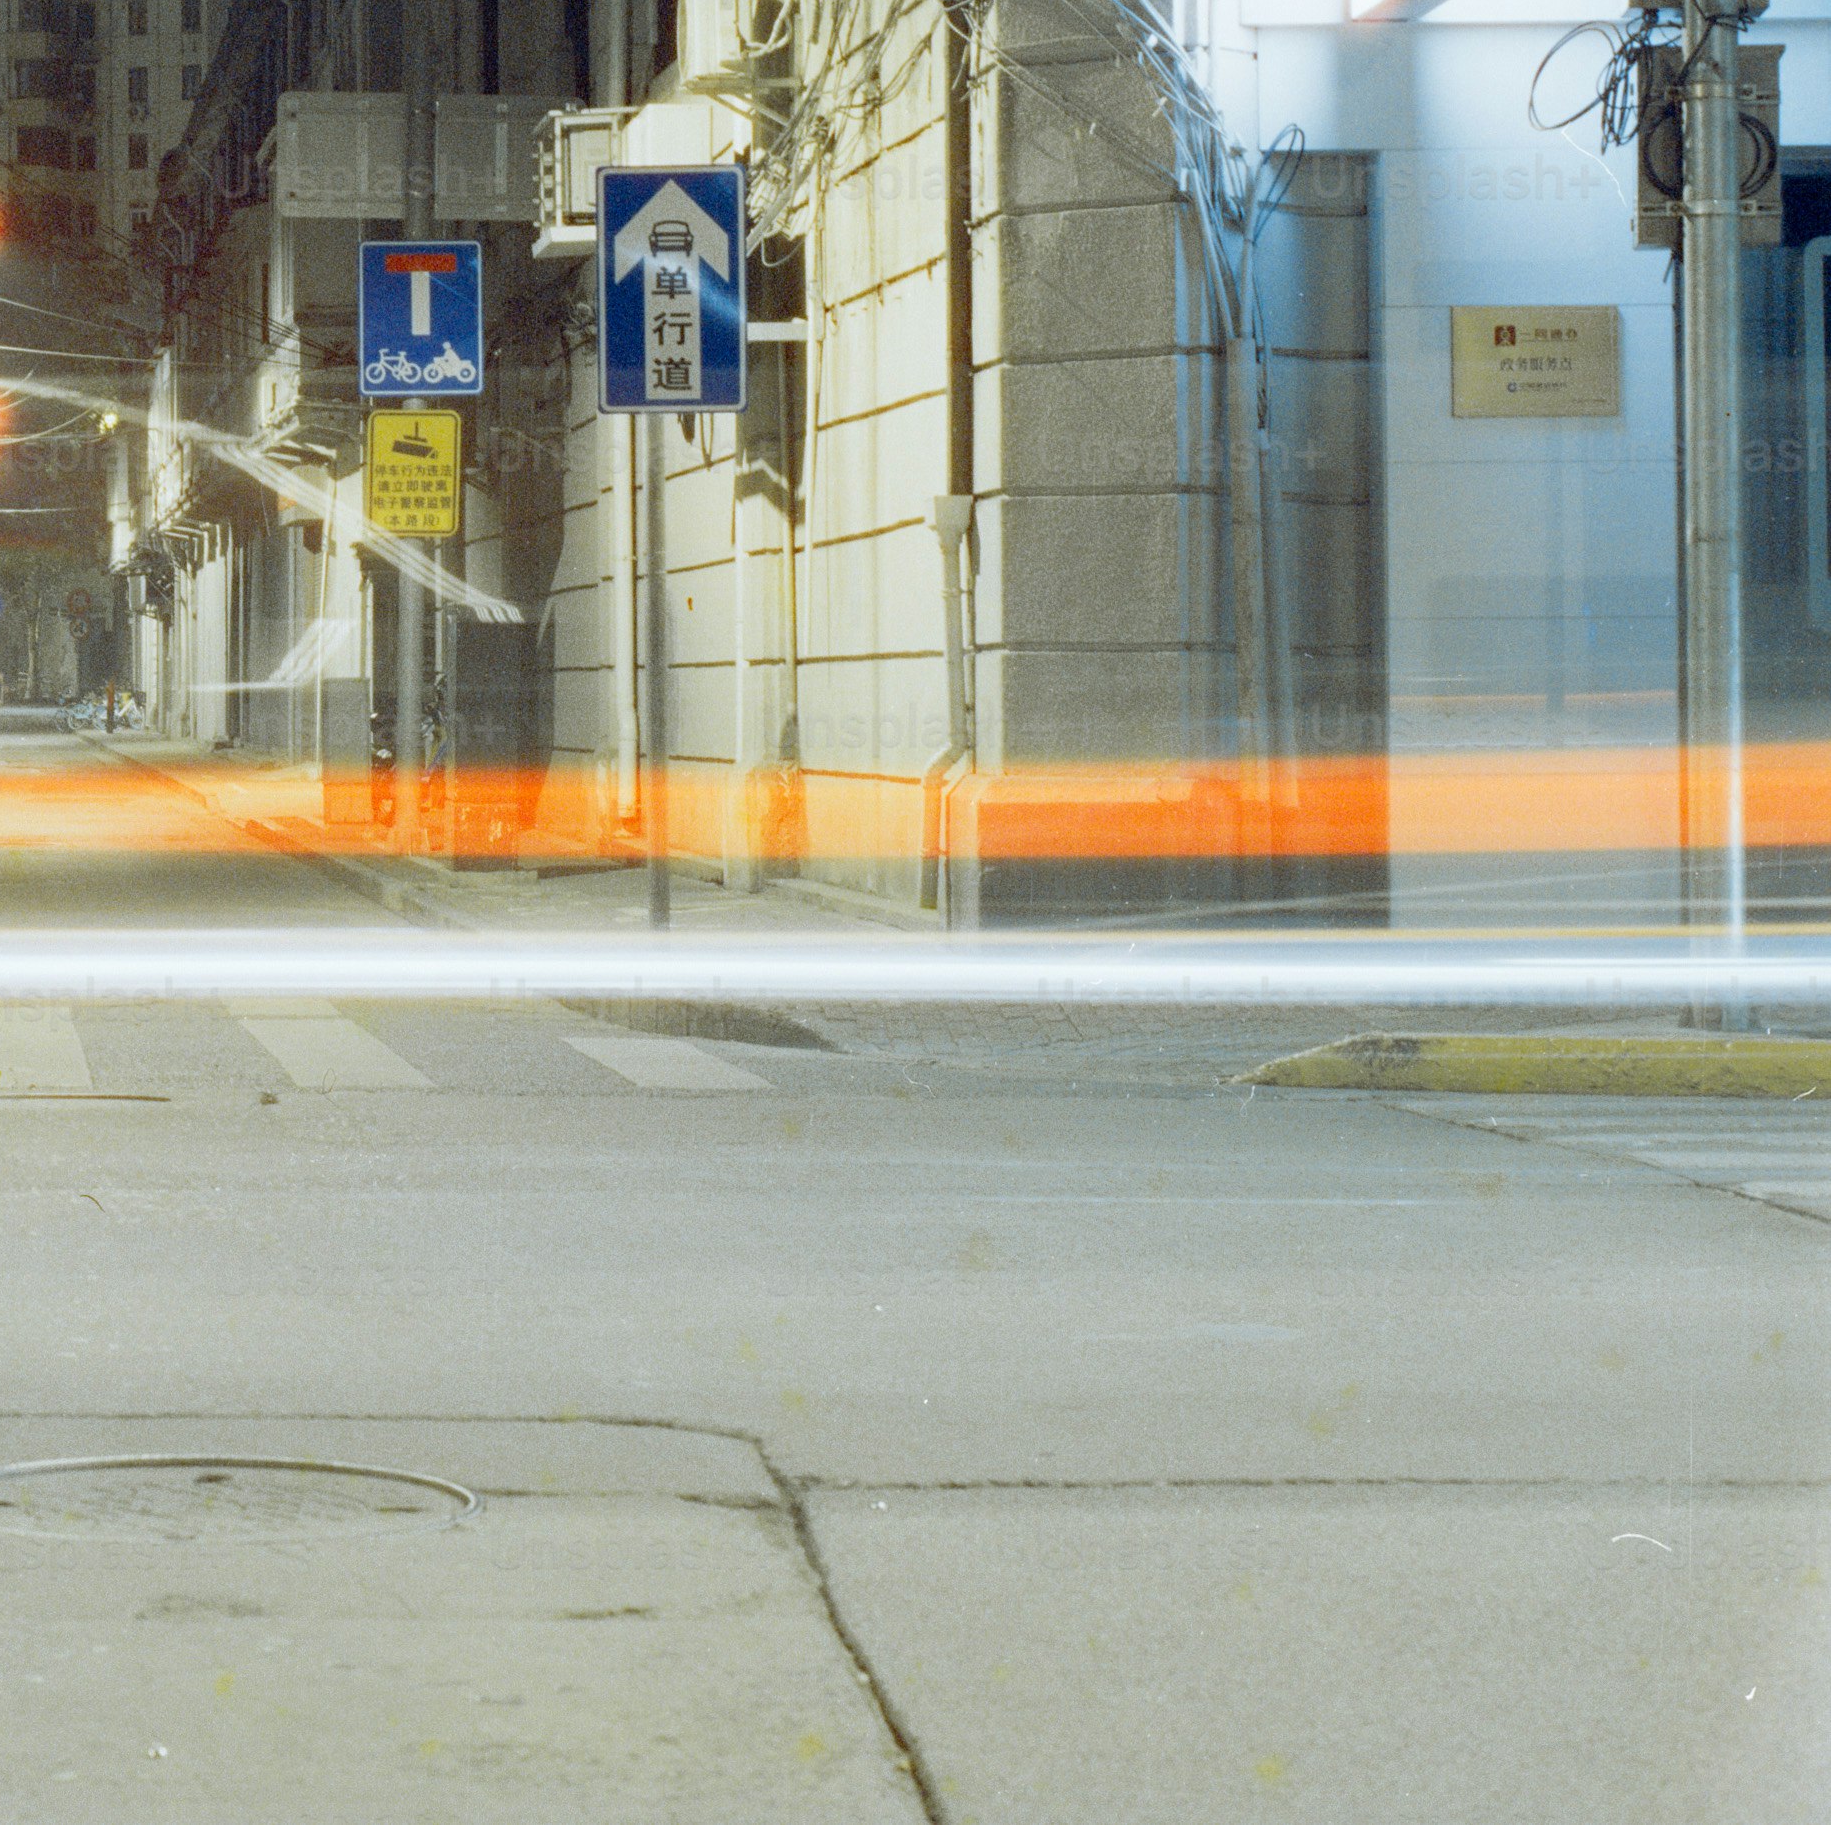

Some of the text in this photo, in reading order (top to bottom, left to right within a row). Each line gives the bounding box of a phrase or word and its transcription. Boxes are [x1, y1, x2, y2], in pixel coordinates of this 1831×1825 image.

[651, 266, 692, 390] 单行道
[1500, 356, 1572, 372] 政务服务点
[375, 463, 452, 478] 停车行为违法
[378, 479, 447, 493] 请立即驶离
